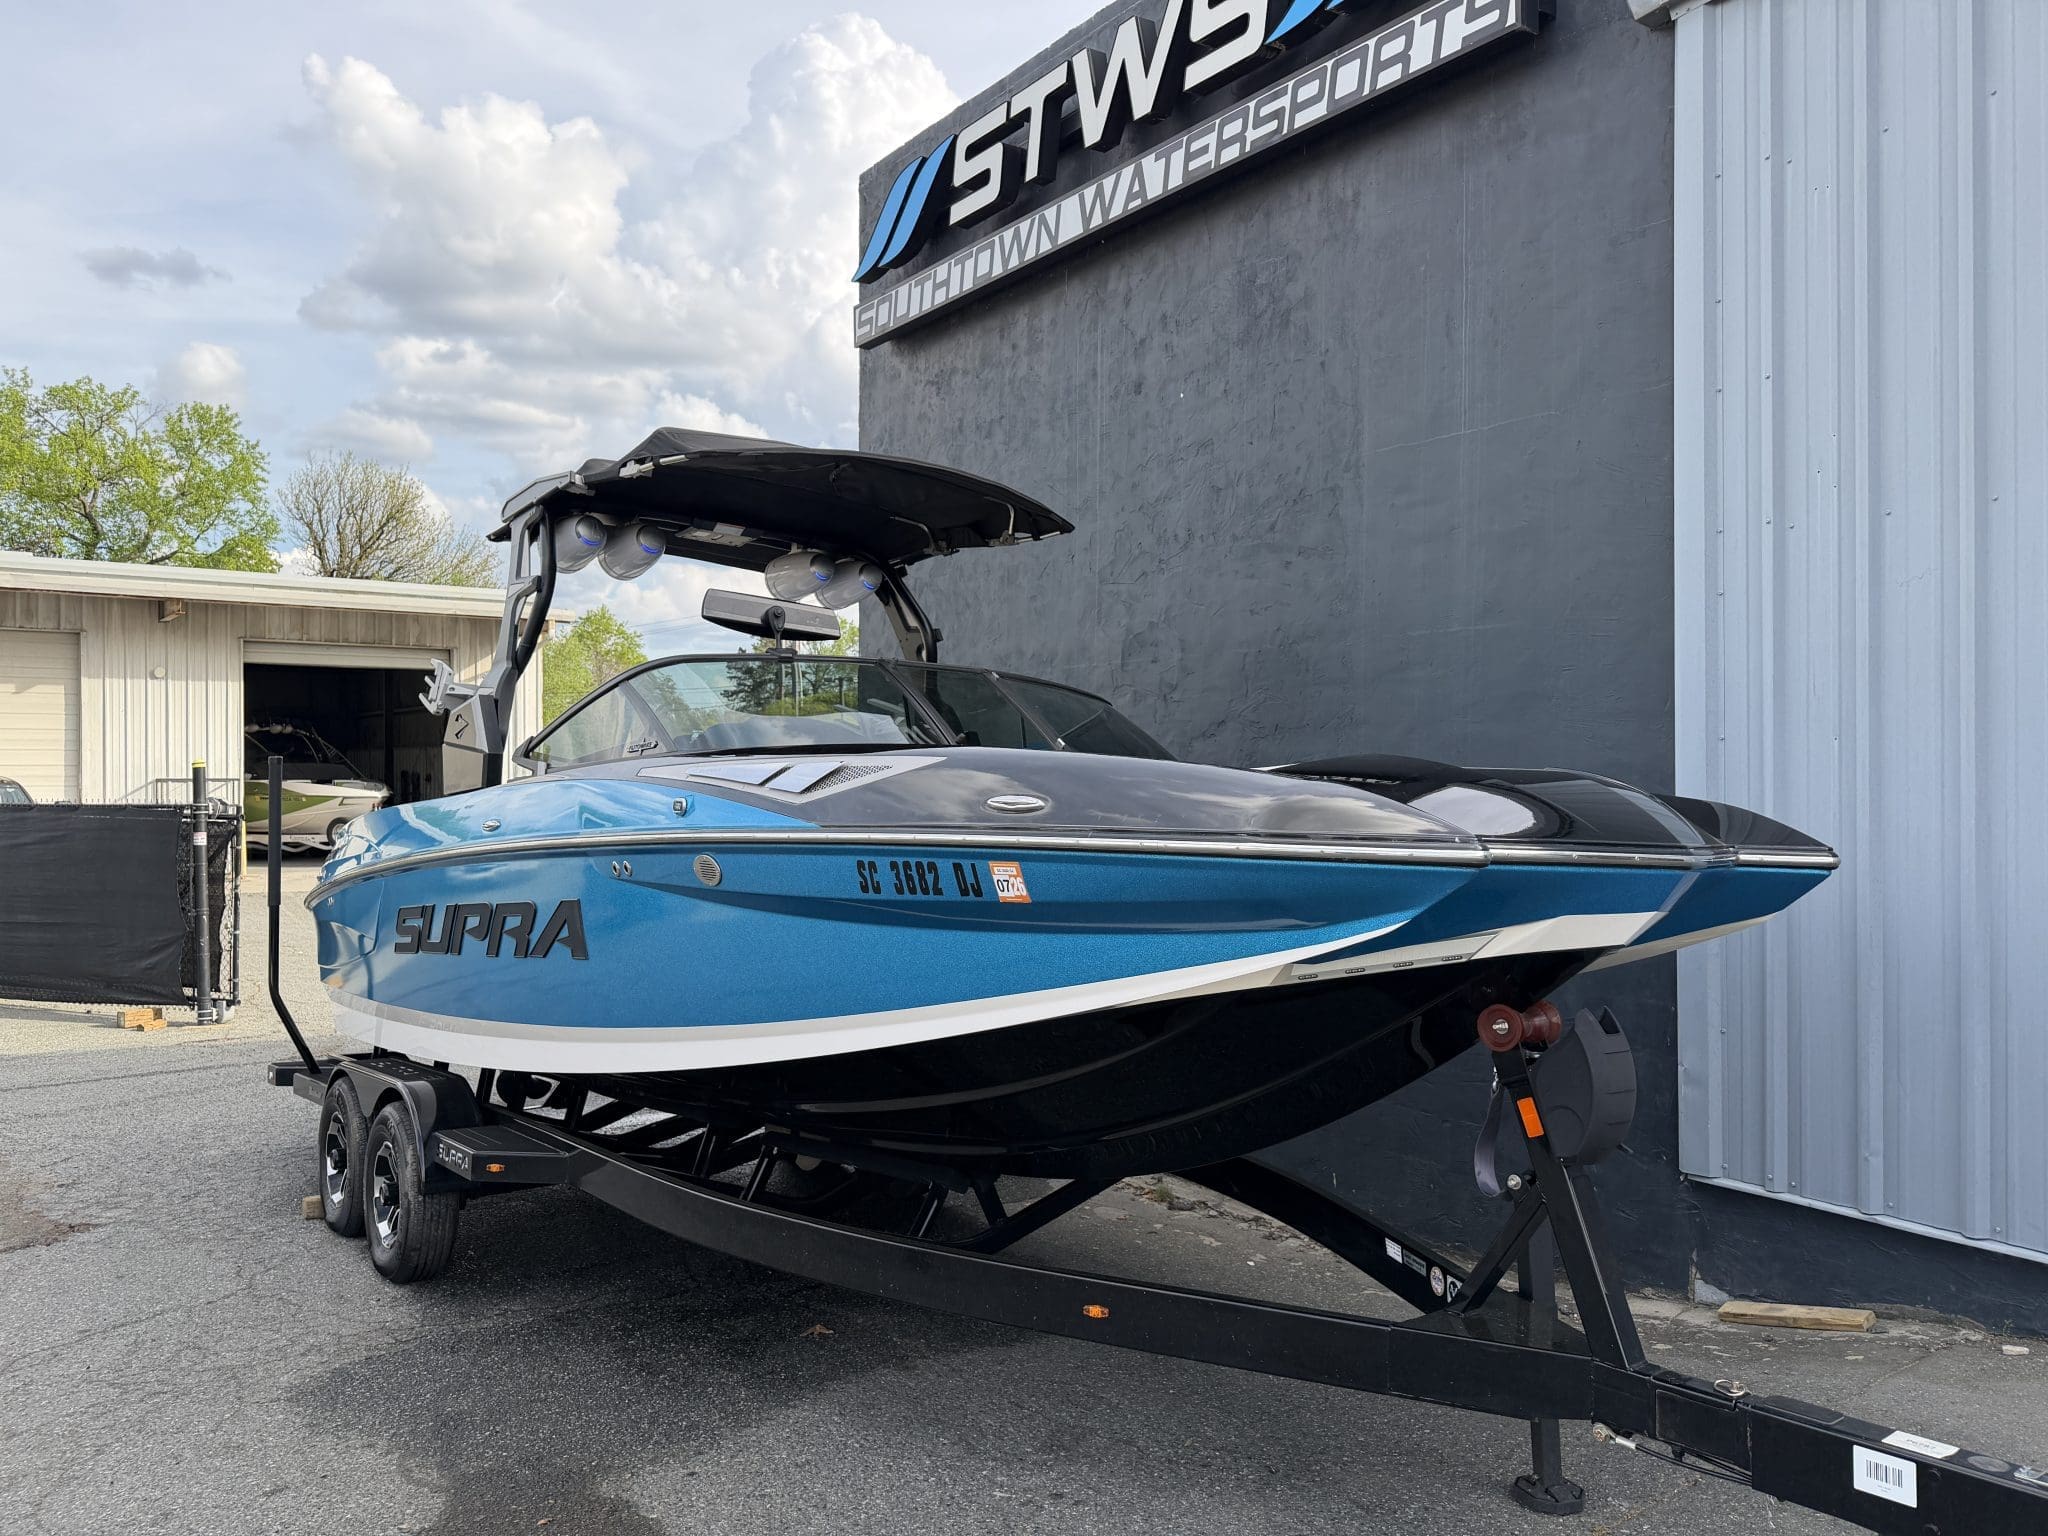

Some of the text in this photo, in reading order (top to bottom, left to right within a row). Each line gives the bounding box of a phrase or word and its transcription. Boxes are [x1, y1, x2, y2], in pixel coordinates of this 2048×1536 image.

[949, 0, 1268, 226] STWS
[856, 0, 1510, 337] SOUTHTOWN WATERSPORTS
[857, 860, 983, 897] SC 3682 DJ
[395, 899, 588, 960] SUPRA
[439, 1143, 469, 1169] SUPRA
